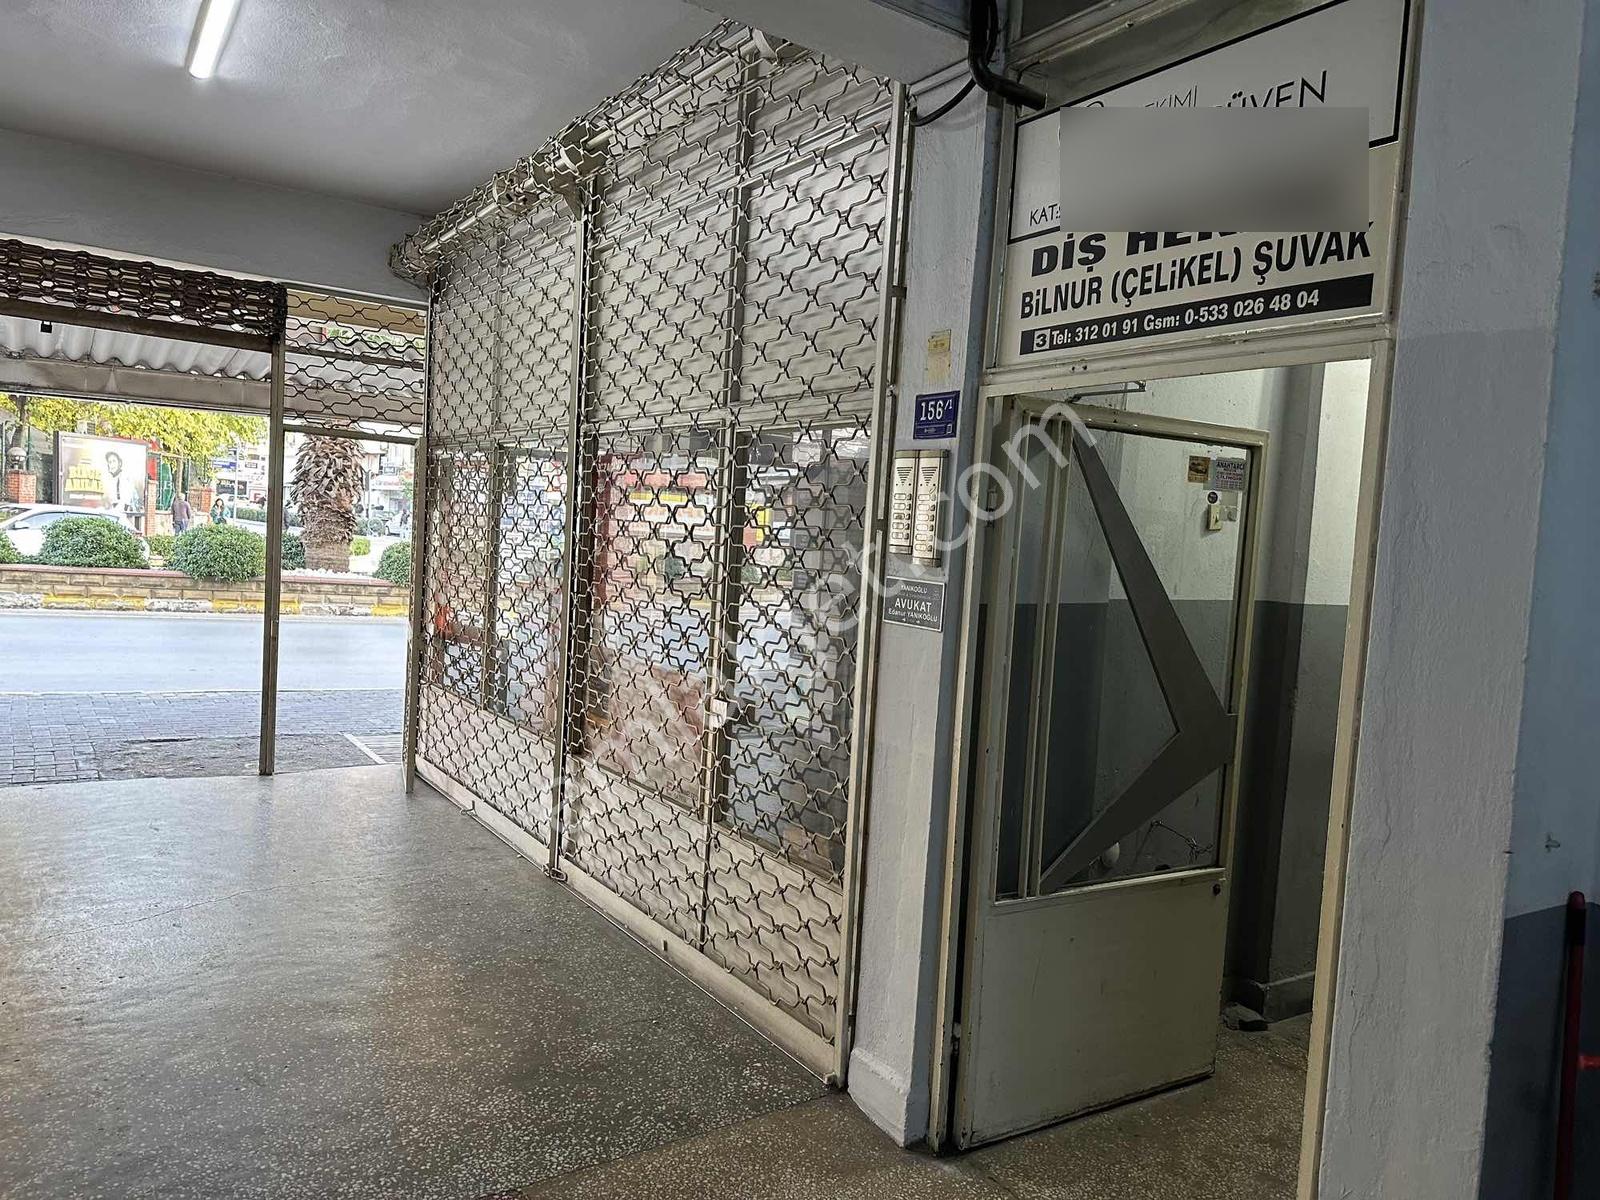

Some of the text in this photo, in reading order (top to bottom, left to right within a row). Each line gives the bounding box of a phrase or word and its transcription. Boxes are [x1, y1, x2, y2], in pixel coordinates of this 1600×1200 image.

[1031, 232, 1107, 277] DİŞ
[1252, 222, 1374, 285] ŞUVAK
[1051, 328, 1072, 345] Tel:
[1074, 324, 1099, 343] 312
[1102, 322, 1117, 338] 01
[1122, 318, 1138, 335] 91
[1143, 314, 1180, 331] Gsm:
[1184, 303, 1228, 325] 0-533
[1233, 298, 1265, 318] 026
[1269, 293, 1291, 311] 48
[1296, 289, 1320, 309] 04
[894, 597, 932, 613] AVUKAT
